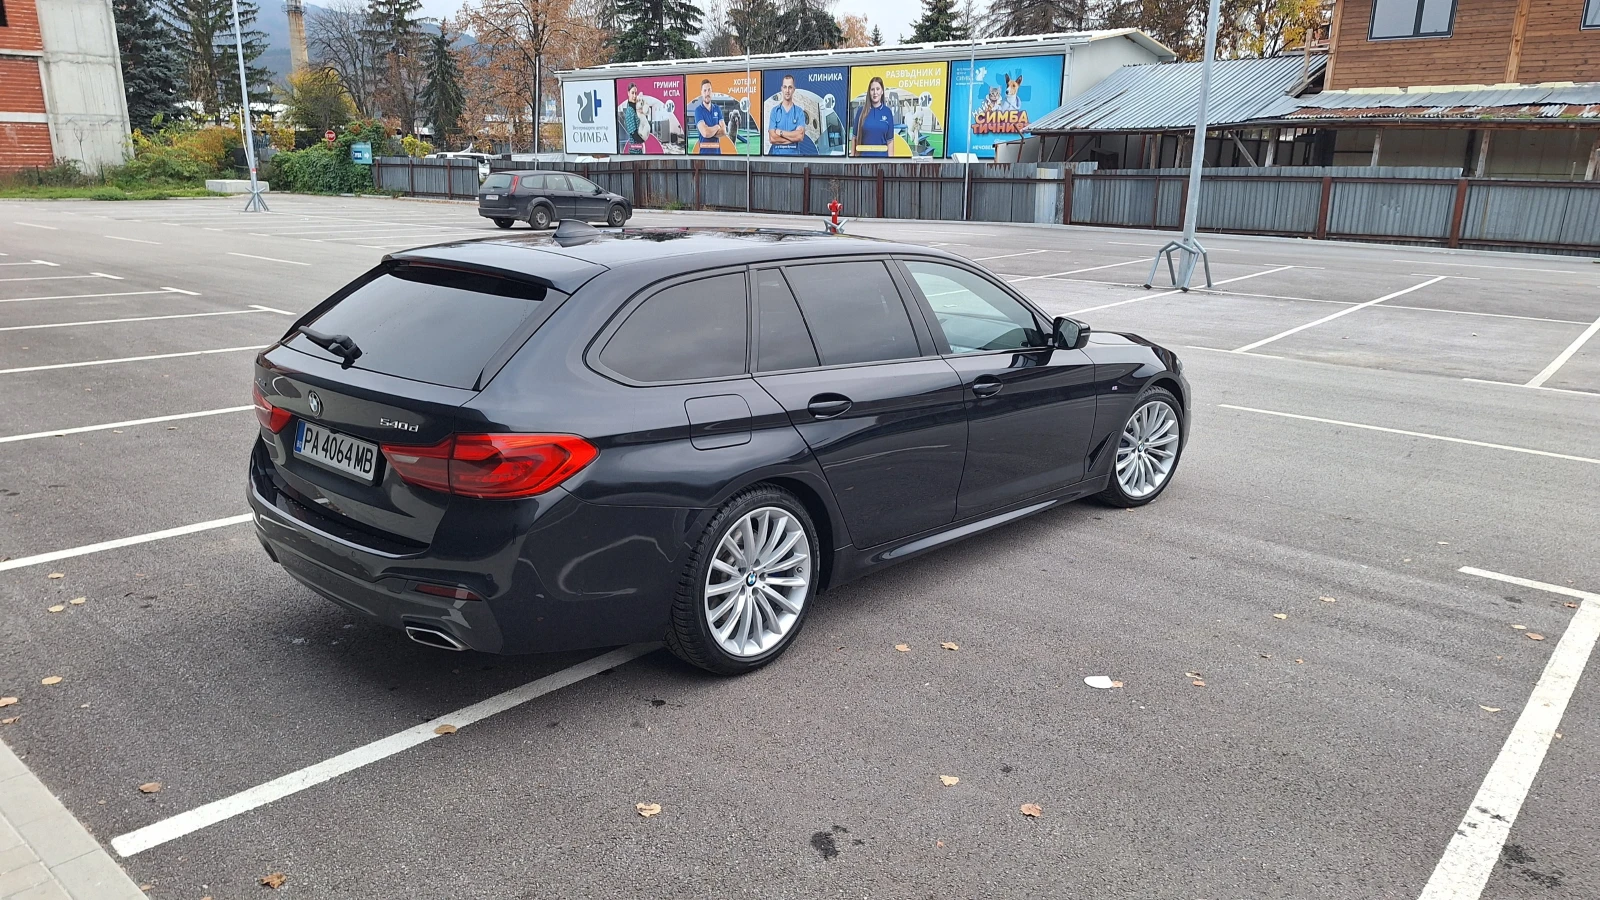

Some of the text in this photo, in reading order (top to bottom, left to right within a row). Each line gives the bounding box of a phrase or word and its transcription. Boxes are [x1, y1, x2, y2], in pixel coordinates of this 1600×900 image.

[808, 73, 843, 82] КЛИНИКА
[885, 68, 941, 79] РАЗВЪДНИК И
[653, 81, 680, 89] ГРУМИНГ
[898, 78, 941, 88] ОБУЧЕНИЯ
[669, 89, 681, 97] СПА
[975, 110, 1028, 124] СИМБА
[972, 122, 1029, 134] ТИЧНИЯ
[572, 131, 609, 143] СИМБА
[379, 417, 419, 433] 540d
[303, 427, 374, 474] PA 4064 MB
